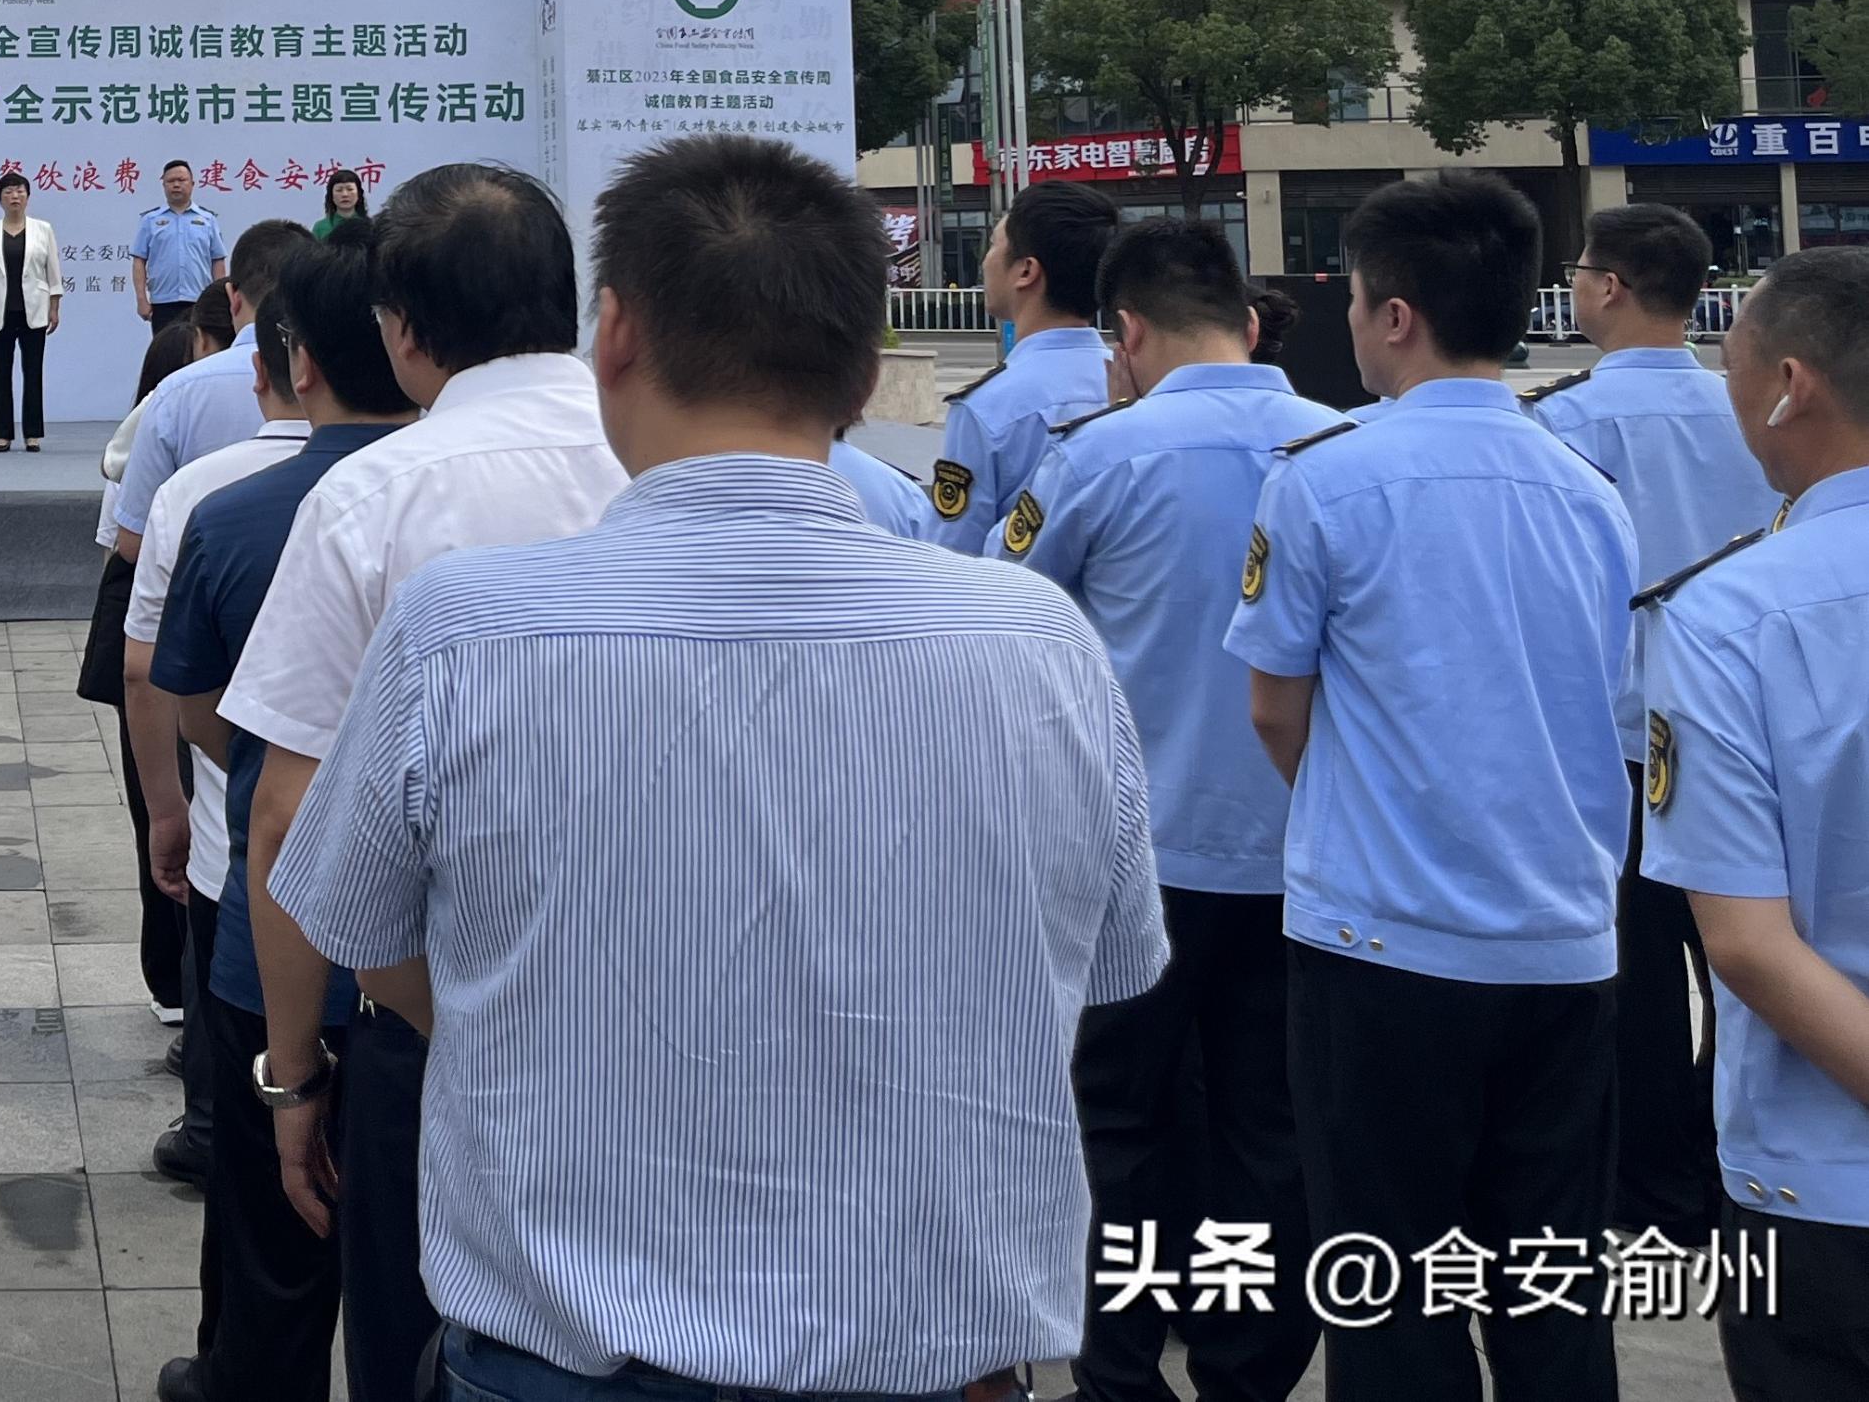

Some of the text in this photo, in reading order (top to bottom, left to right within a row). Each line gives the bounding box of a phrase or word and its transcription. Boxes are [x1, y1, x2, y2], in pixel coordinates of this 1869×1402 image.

[586, 69, 831, 85] 綦江区2023年全国食品安全宣传周
[644, 94, 774, 110] 诚信教育主题活动
[159, 157, 387, 195] 建食安城市
